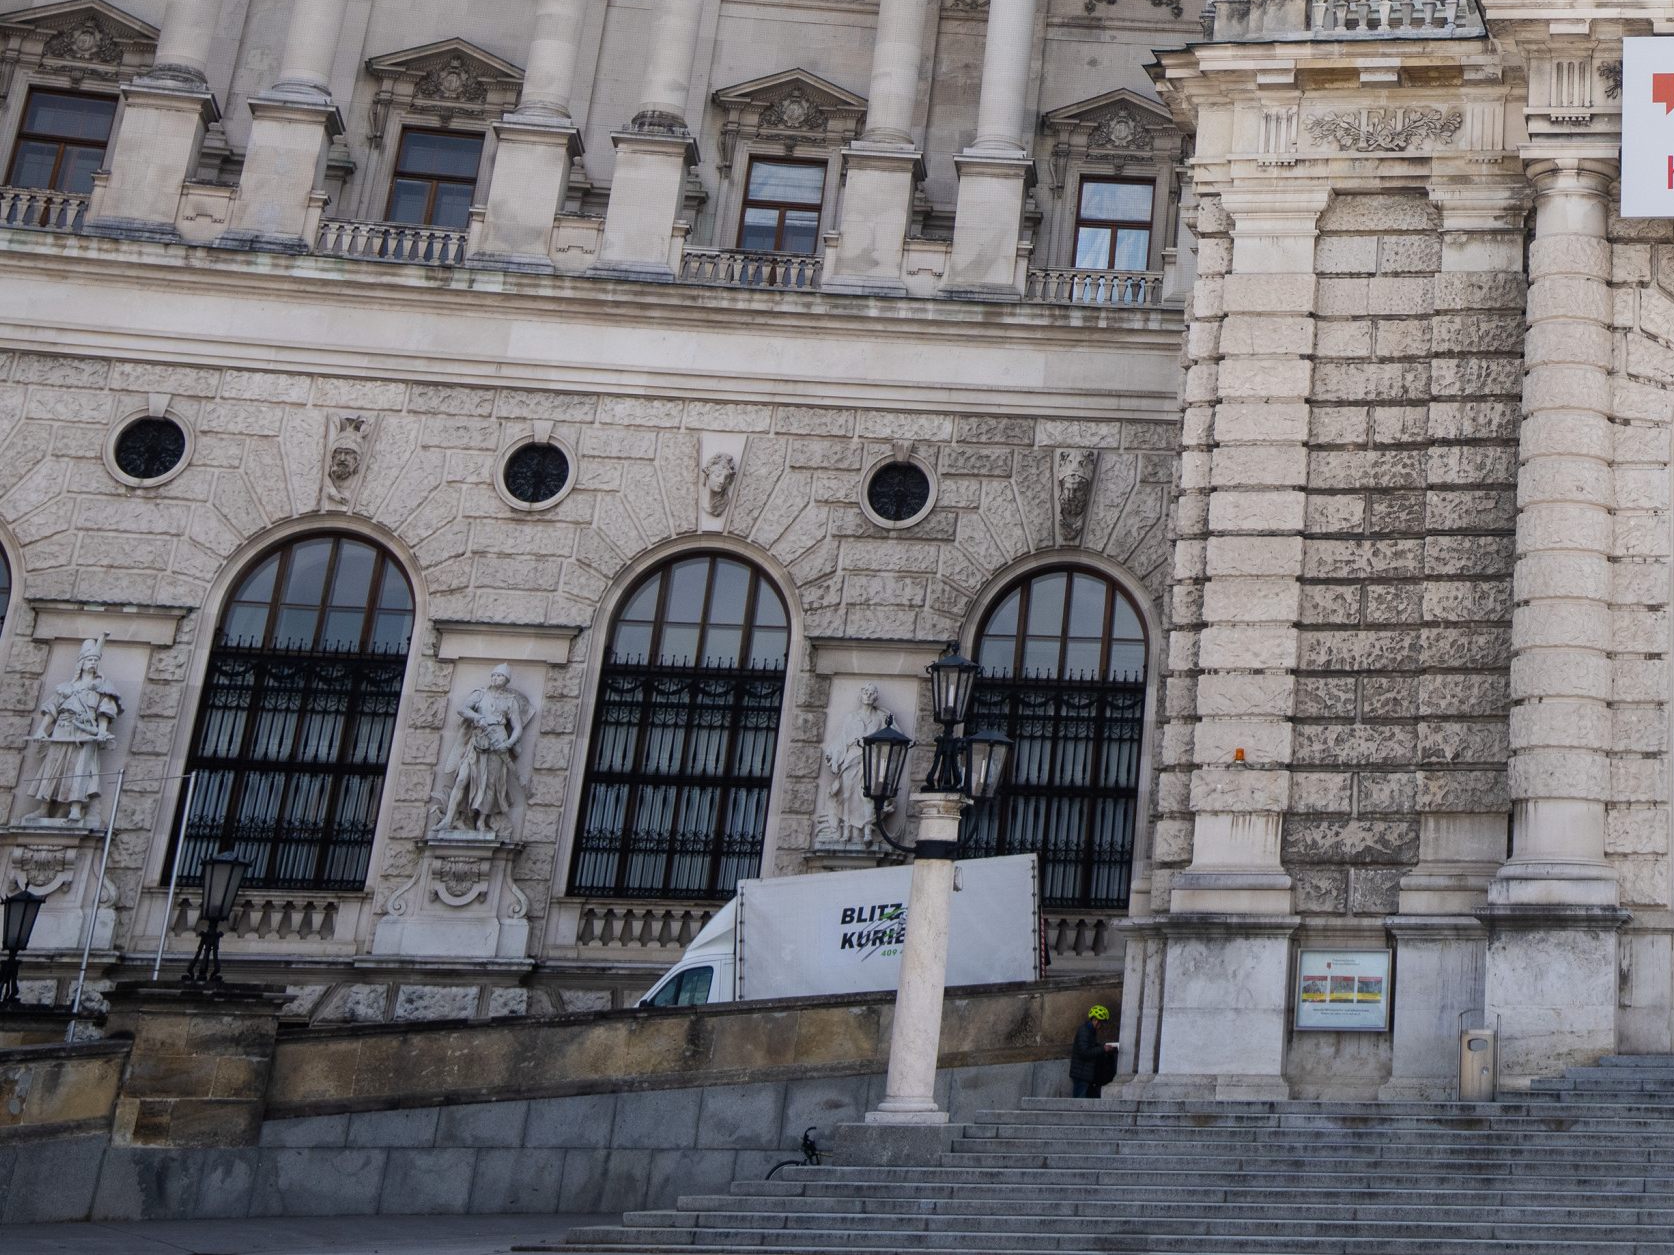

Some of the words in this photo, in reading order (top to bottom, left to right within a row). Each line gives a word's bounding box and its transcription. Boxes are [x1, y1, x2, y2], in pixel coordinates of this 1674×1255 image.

[840, 903, 905, 925] BLITZ
[840, 927, 906, 950] KURIE
[881, 949, 898, 957] 409
